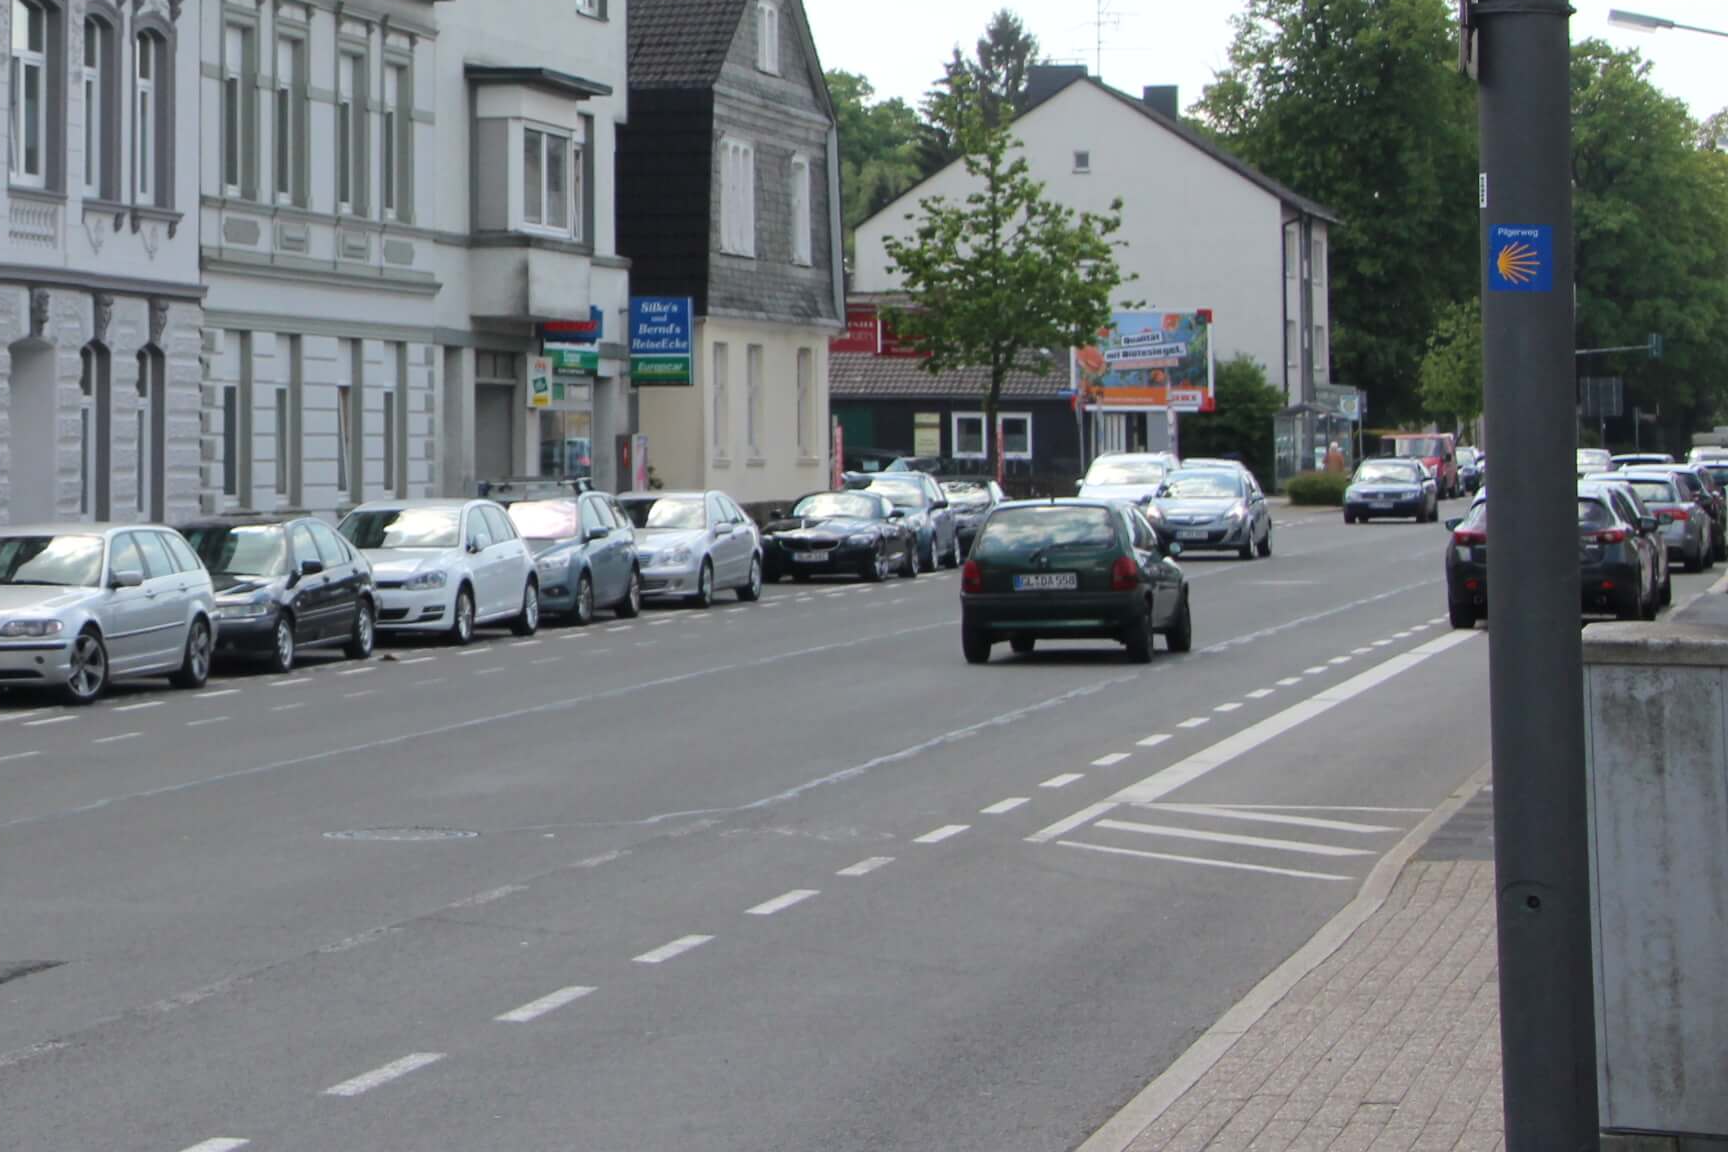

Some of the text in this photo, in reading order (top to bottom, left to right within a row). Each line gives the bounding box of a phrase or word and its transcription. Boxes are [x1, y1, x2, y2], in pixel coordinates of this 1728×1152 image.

[1498, 227, 1539, 238] Pilgerweg
[641, 301, 678, 313] Silke's
[651, 313, 667, 322] und
[639, 323, 681, 335] Bernd's
[632, 337, 688, 349] ReiseEcke
